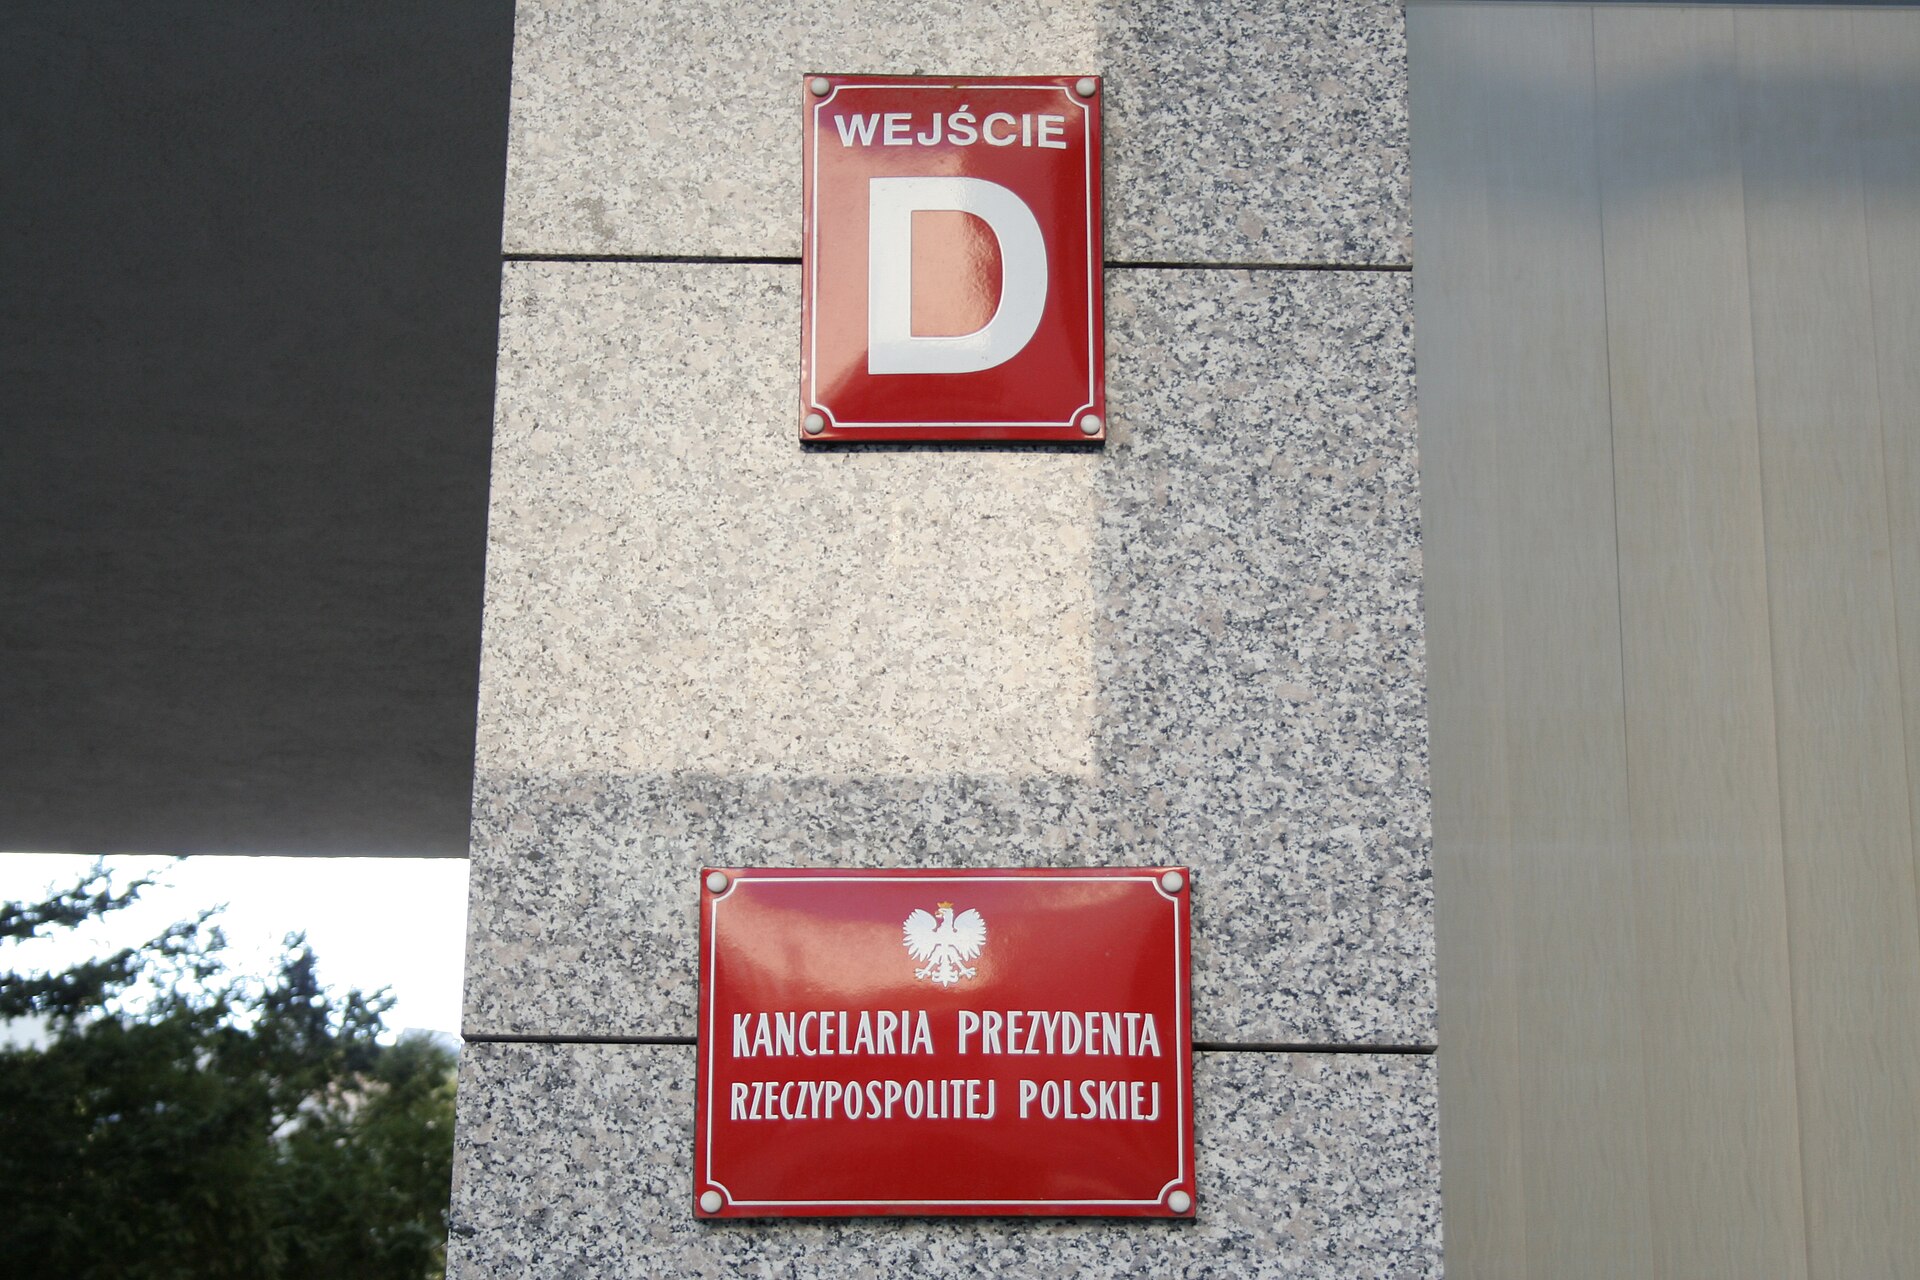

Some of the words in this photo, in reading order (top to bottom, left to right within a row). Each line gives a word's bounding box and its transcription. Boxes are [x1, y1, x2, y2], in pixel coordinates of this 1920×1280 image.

[833, 104, 1068, 150] WEJŚCIE
[867, 176, 1049, 375] D
[732, 1010, 935, 1058] KANCELARIA
[958, 1010, 1162, 1057] PREZYDENTA
[730, 1079, 996, 1121] RZECZYPOSPOLITEJ
[1019, 1079, 1160, 1121] POLSKIEJ
